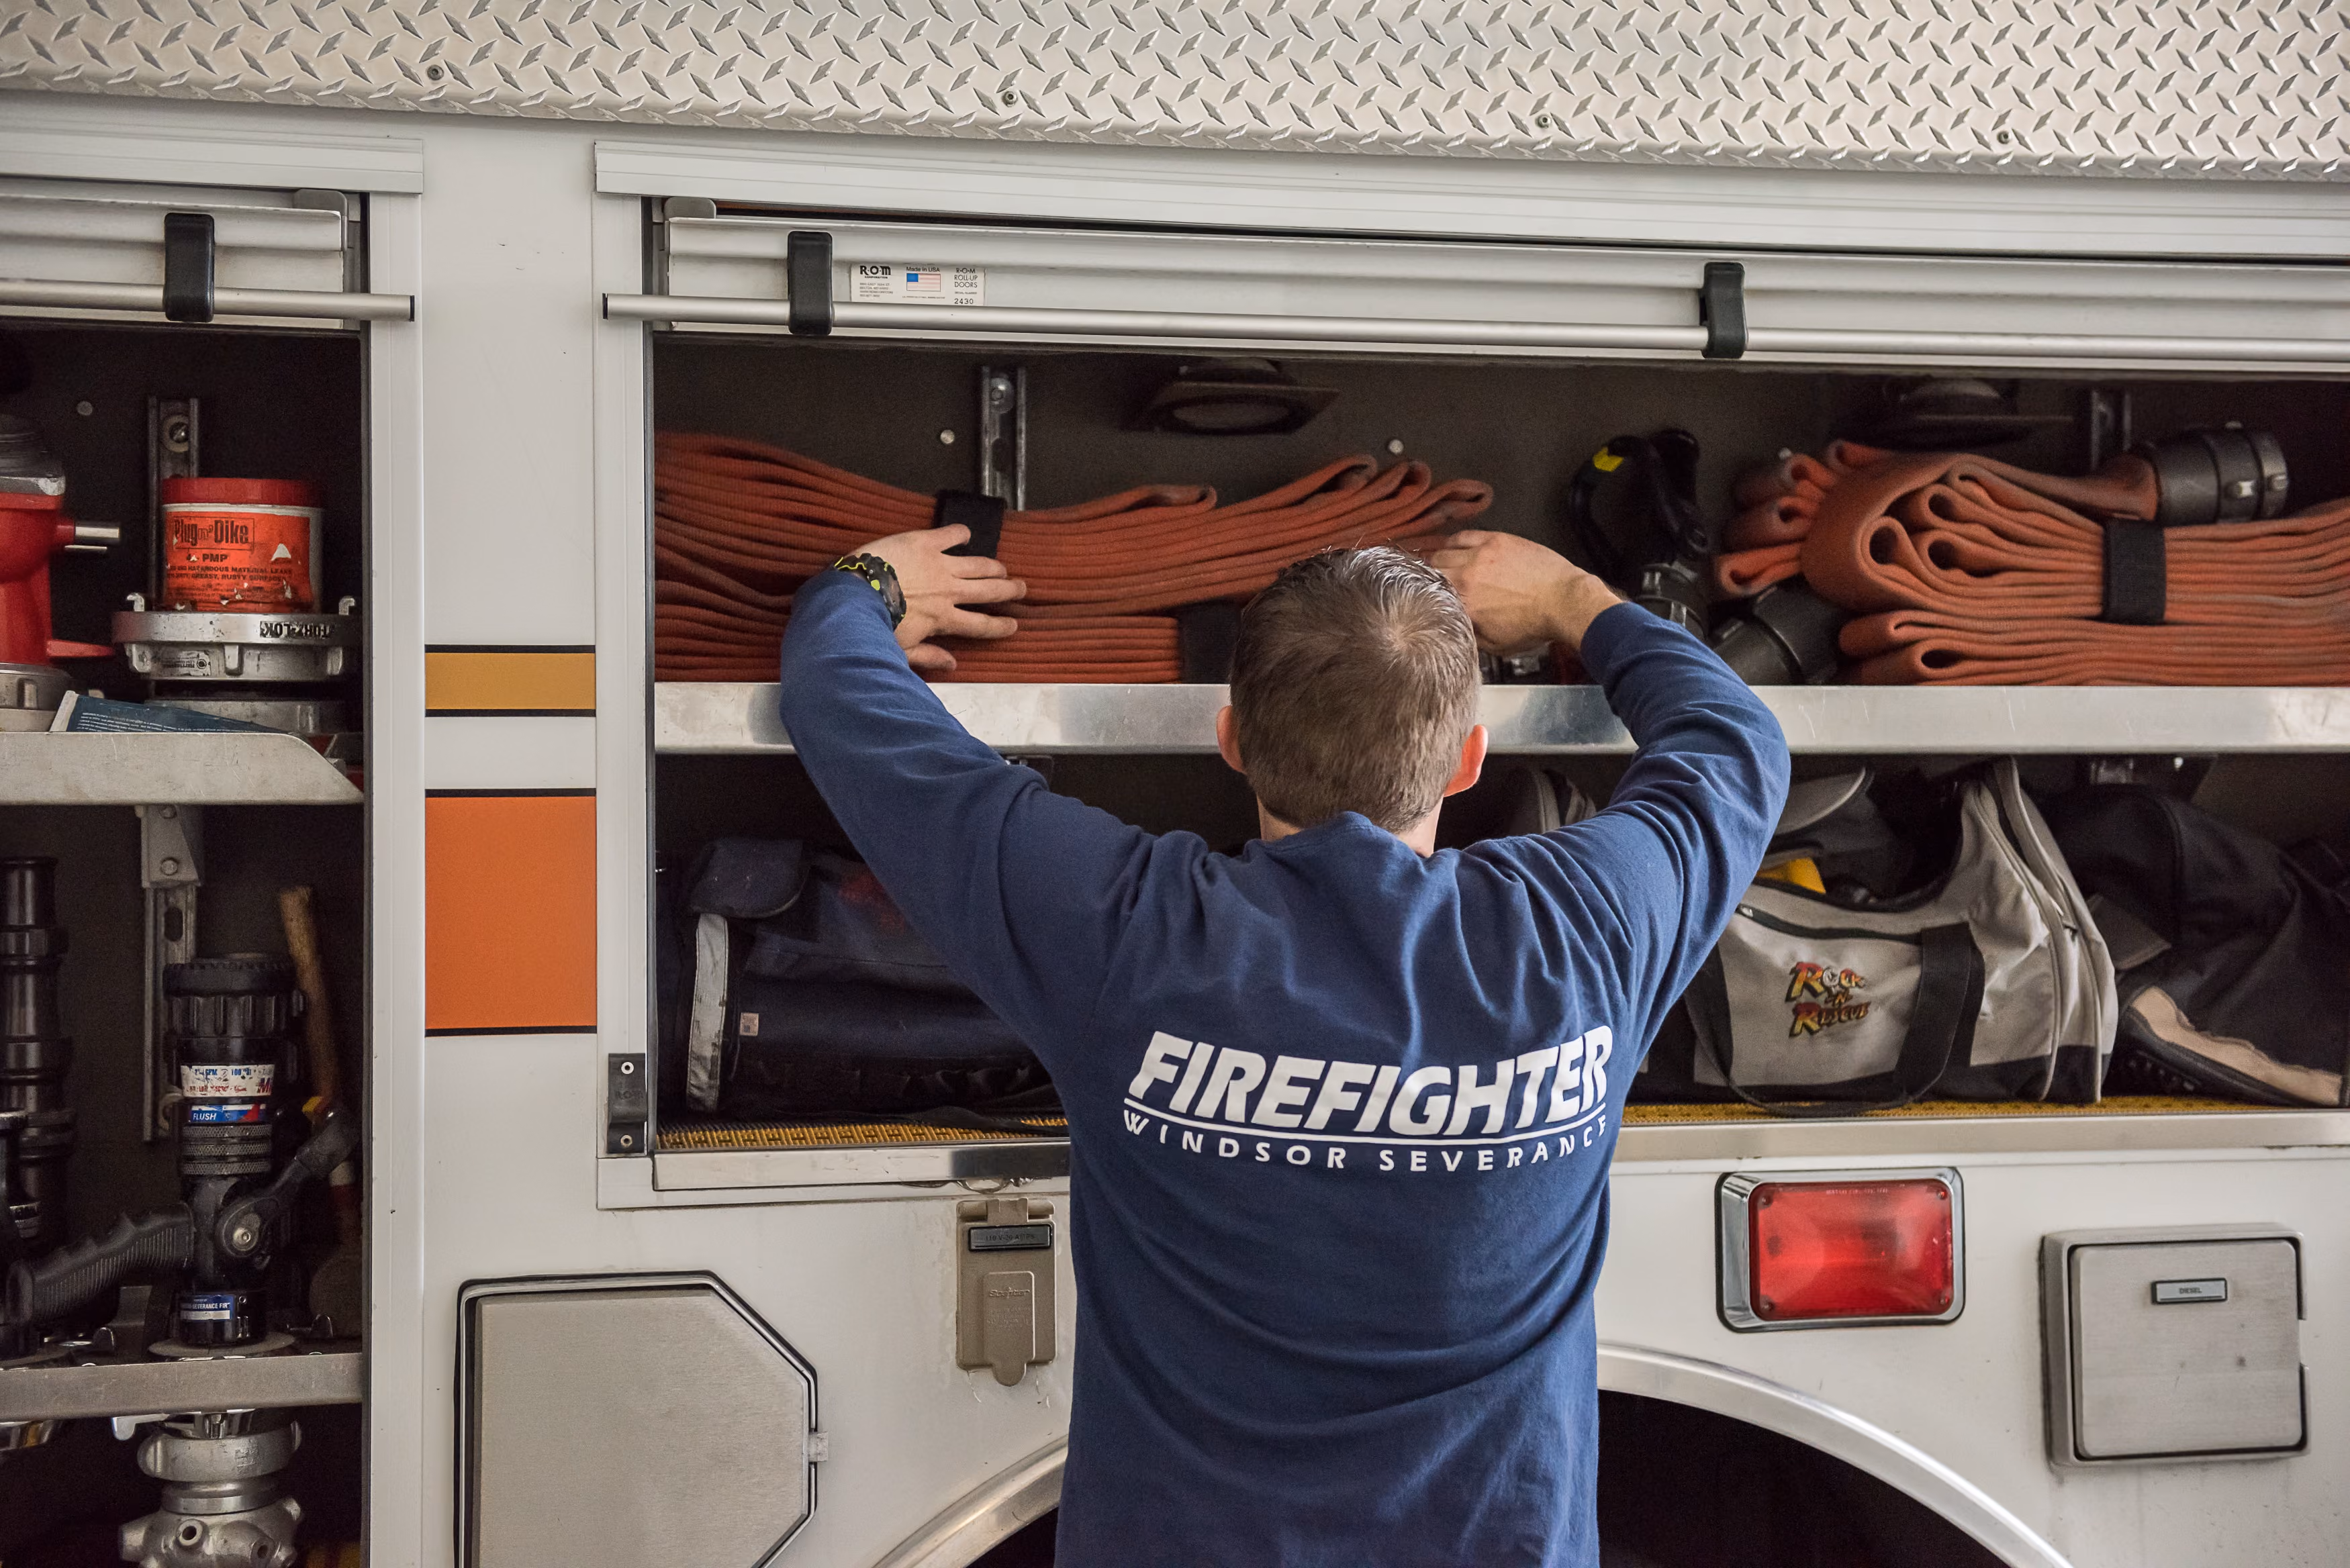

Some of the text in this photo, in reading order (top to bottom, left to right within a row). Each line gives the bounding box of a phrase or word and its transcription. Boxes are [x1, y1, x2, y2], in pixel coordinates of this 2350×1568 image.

[173, 519, 198, 546] Plug
[214, 520, 249, 544] Dike
[202, 554, 228, 562] PMP
[1129, 1026, 1613, 1136] FIREFIGHTER
[193, 1113, 217, 1121] FLUSH
[1124, 1110, 1607, 1171] WINDSOR SEVERANCE
